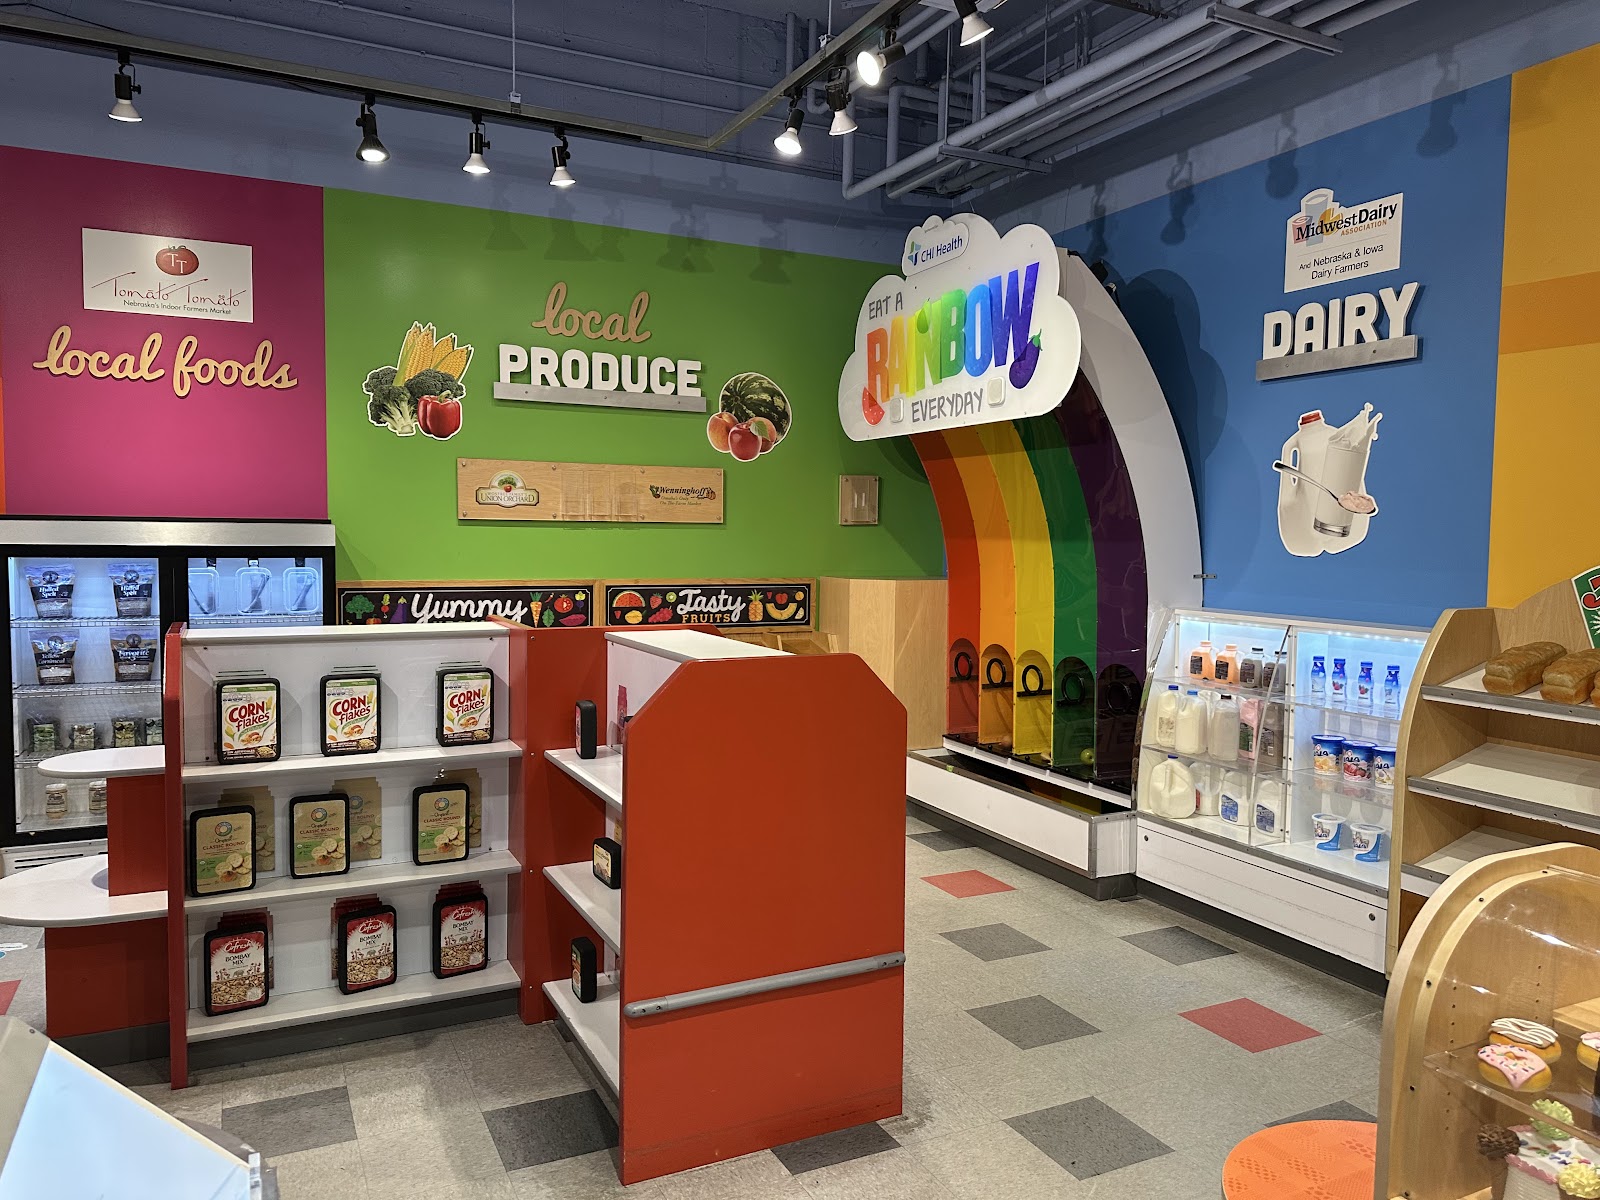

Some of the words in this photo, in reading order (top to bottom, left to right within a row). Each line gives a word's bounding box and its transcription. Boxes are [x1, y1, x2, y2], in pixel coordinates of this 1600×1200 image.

[1340, 219, 1388, 236] ASSOCIATION
[921, 246, 935, 263] CHI
[936, 235, 963, 257] Health
[1299, 262, 1311, 271] And
[1313, 251, 1352, 267] Nebraska
[1354, 248, 1361, 258] &
[1363, 244, 1384, 255] Iowa
[1311, 268, 1333, 279] Dairy
[1334, 260, 1369, 274] Farmers
[123, 299, 159, 309] Nebraska's
[160, 301, 181, 310] Indoor
[183, 303, 208, 313] Farmers
[209, 305, 232, 315] Market
[531, 281, 652, 343] local
[868, 295, 892, 320] EAT
[895, 291, 903, 311] A
[1262, 282, 1420, 360] DAIRY
[867, 262, 1040, 403] RAINBOW
[32, 325, 165, 381] local
[173, 335, 298, 397] foods
[499, 343, 702, 398] PRODUCE
[911, 388, 984, 422] EVERYDAY
[411, 593, 528, 624] Yummy
[676, 589, 747, 622] Tasty
[681, 613, 731, 624] FRUITS
[332, 695, 367, 717] CORN
[449, 688, 481, 709] CORN
[455, 698, 485, 717] flakes
[228, 700, 265, 723] CORN
[235, 712, 270, 732] flakes
[339, 705, 371, 725] flakes
[202, 843, 224, 851] CLASSIC
[452, 919, 474, 929] BOMBAY
[359, 933, 383, 943] BOMBAY
[225, 952, 251, 962] BOMBAY
